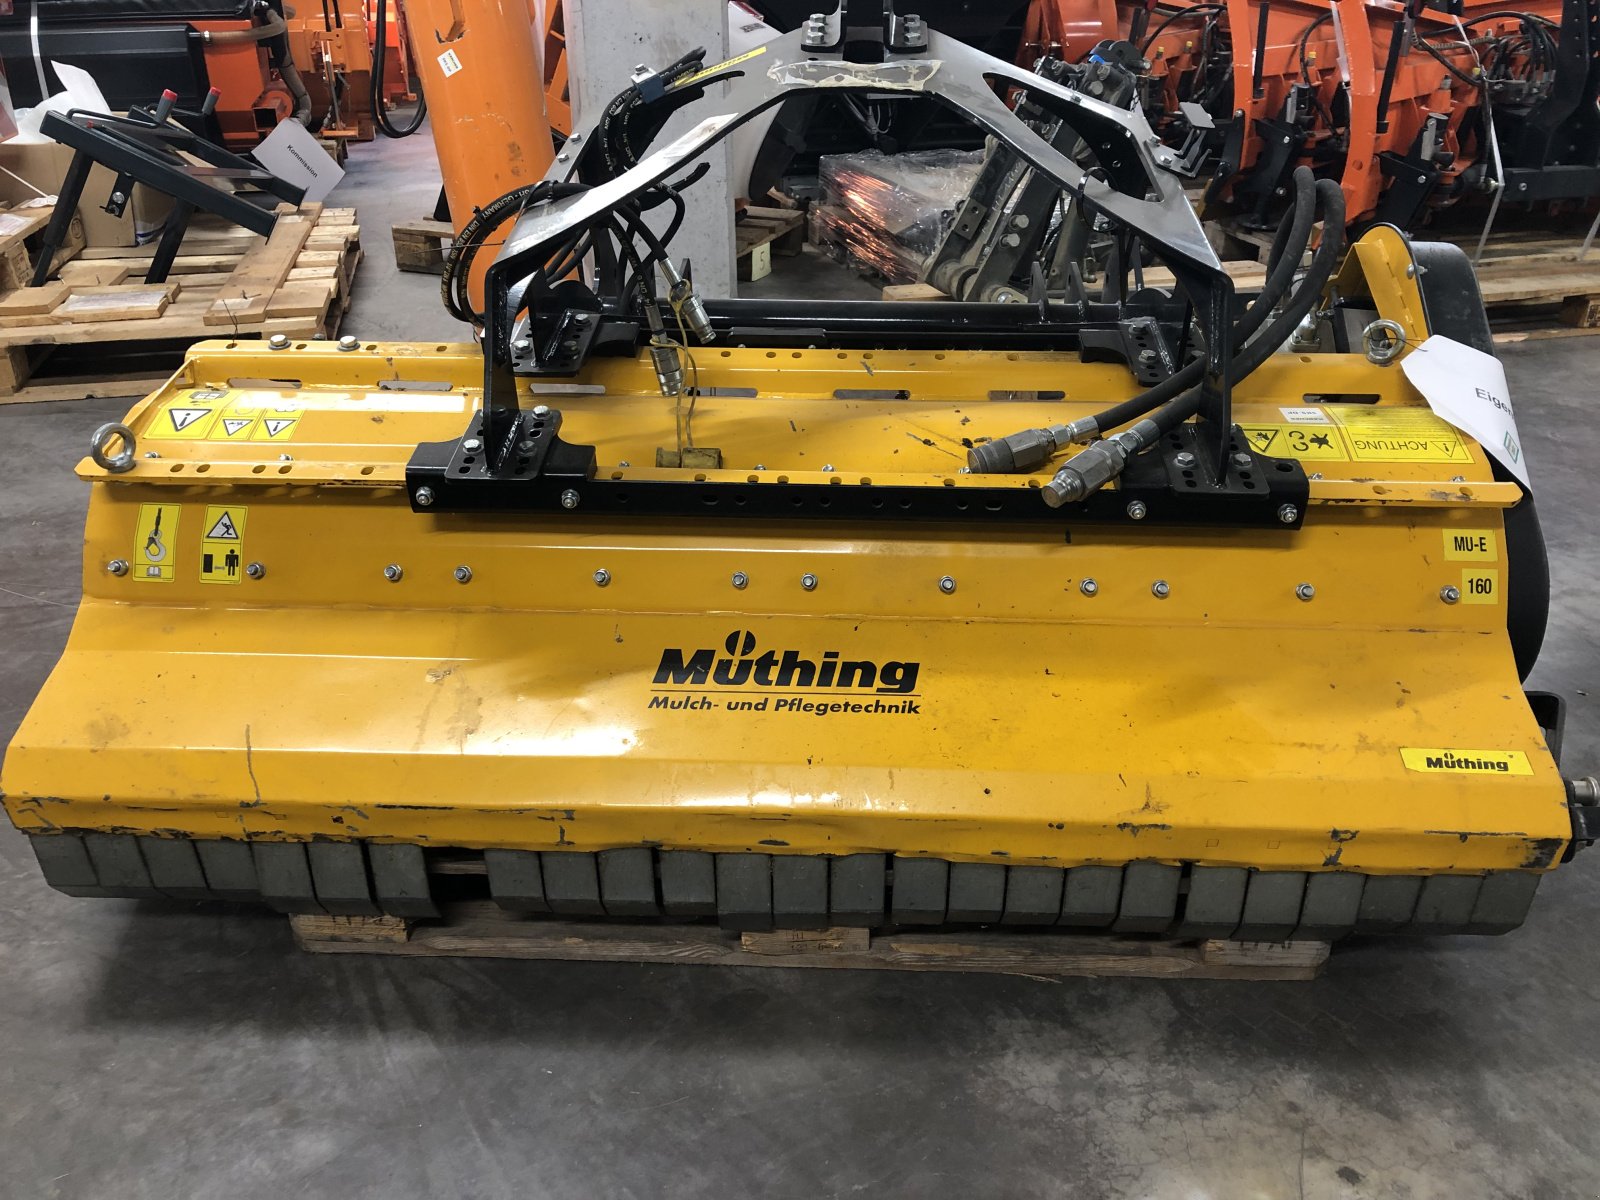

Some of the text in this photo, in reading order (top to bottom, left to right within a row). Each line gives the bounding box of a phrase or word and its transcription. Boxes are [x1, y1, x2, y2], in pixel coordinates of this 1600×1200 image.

[287, 144, 318, 178] Kommission
[482, 195, 514, 219] GERMANY
[461, 229, 472, 240] EN
[1354, 440, 1428, 451] ACHTUNG
[1454, 536, 1487, 552] MU-E
[1468, 578, 1492, 595] 160
[652, 630, 920, 693] Müthing
[648, 696, 921, 716] Mulch- und Pflegetechnik
[1425, 752, 1509, 772] Müthing
